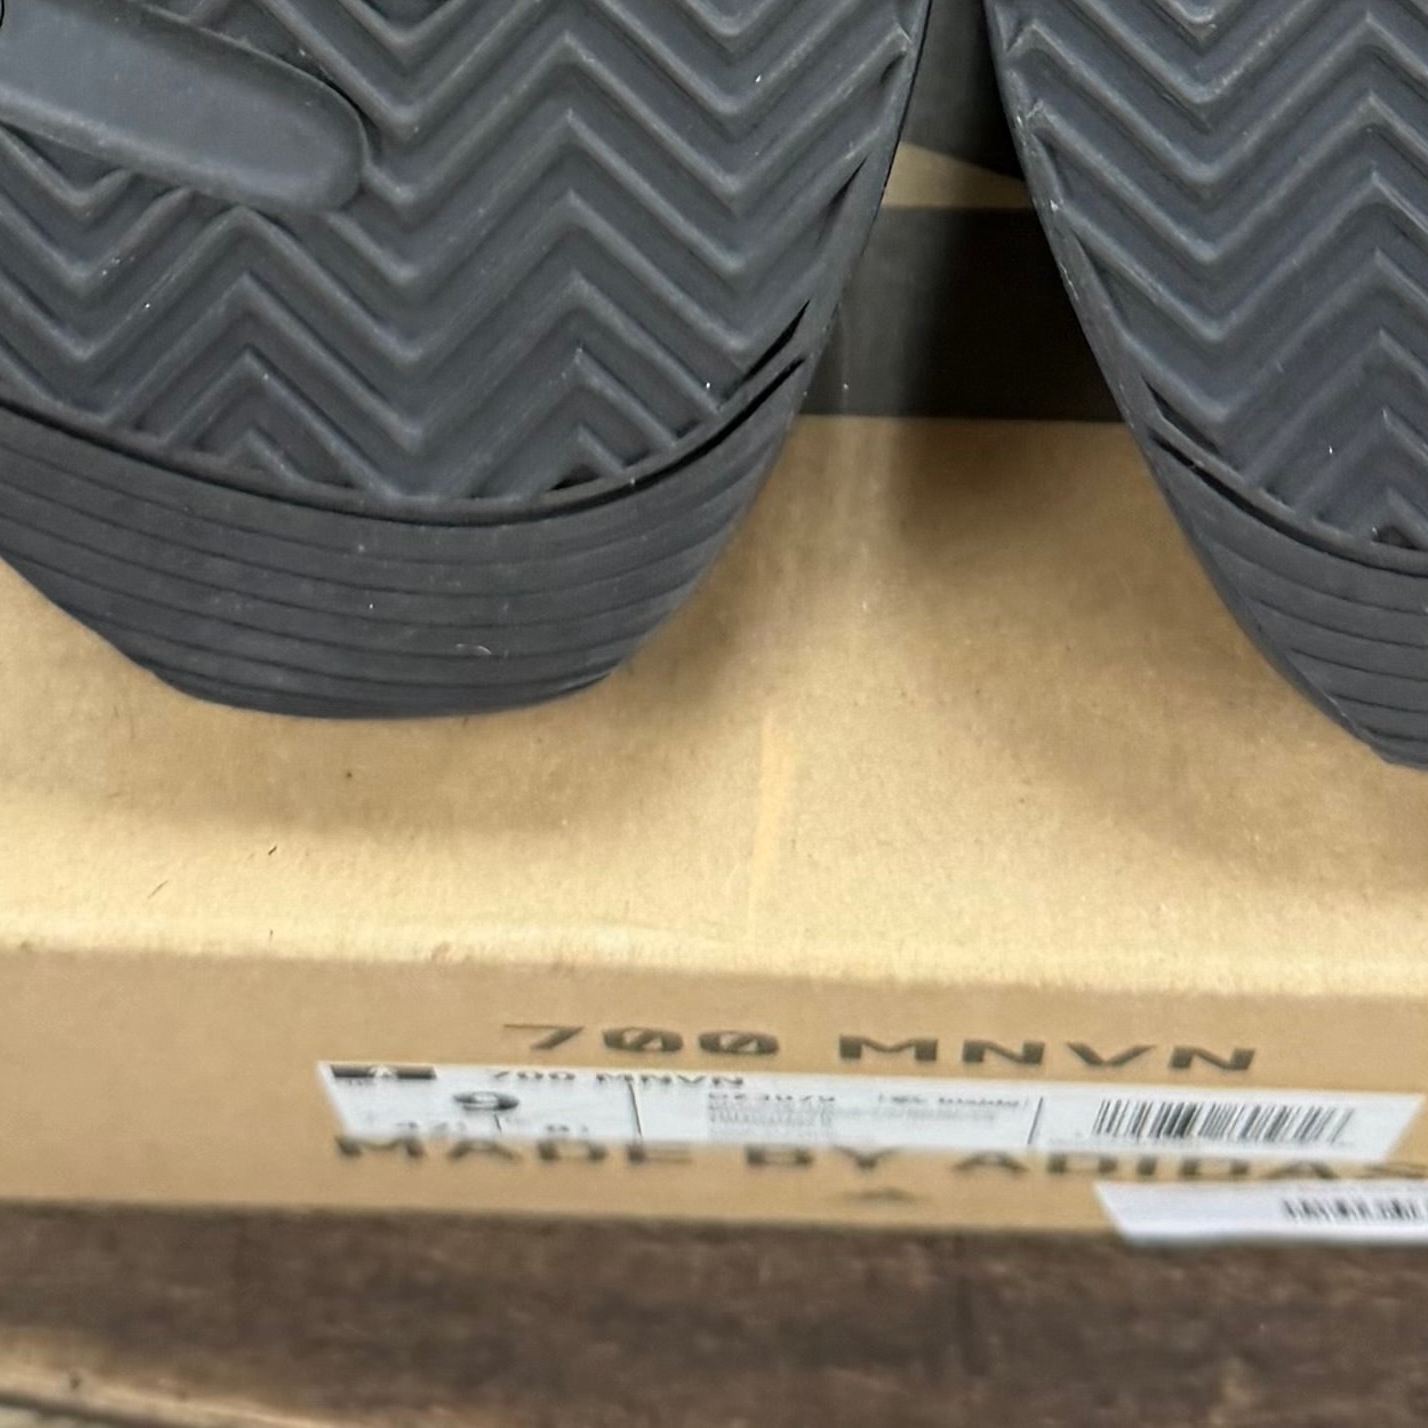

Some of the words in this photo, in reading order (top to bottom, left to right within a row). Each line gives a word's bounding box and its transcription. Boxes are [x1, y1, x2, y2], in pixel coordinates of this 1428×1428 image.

[503, 1024, 780, 1054] 700
[838, 1032, 1255, 1071] MNVN
[494, 1070, 575, 1082] 700
[596, 1073, 744, 1089] MNVN
[452, 1090, 520, 1112] 9
